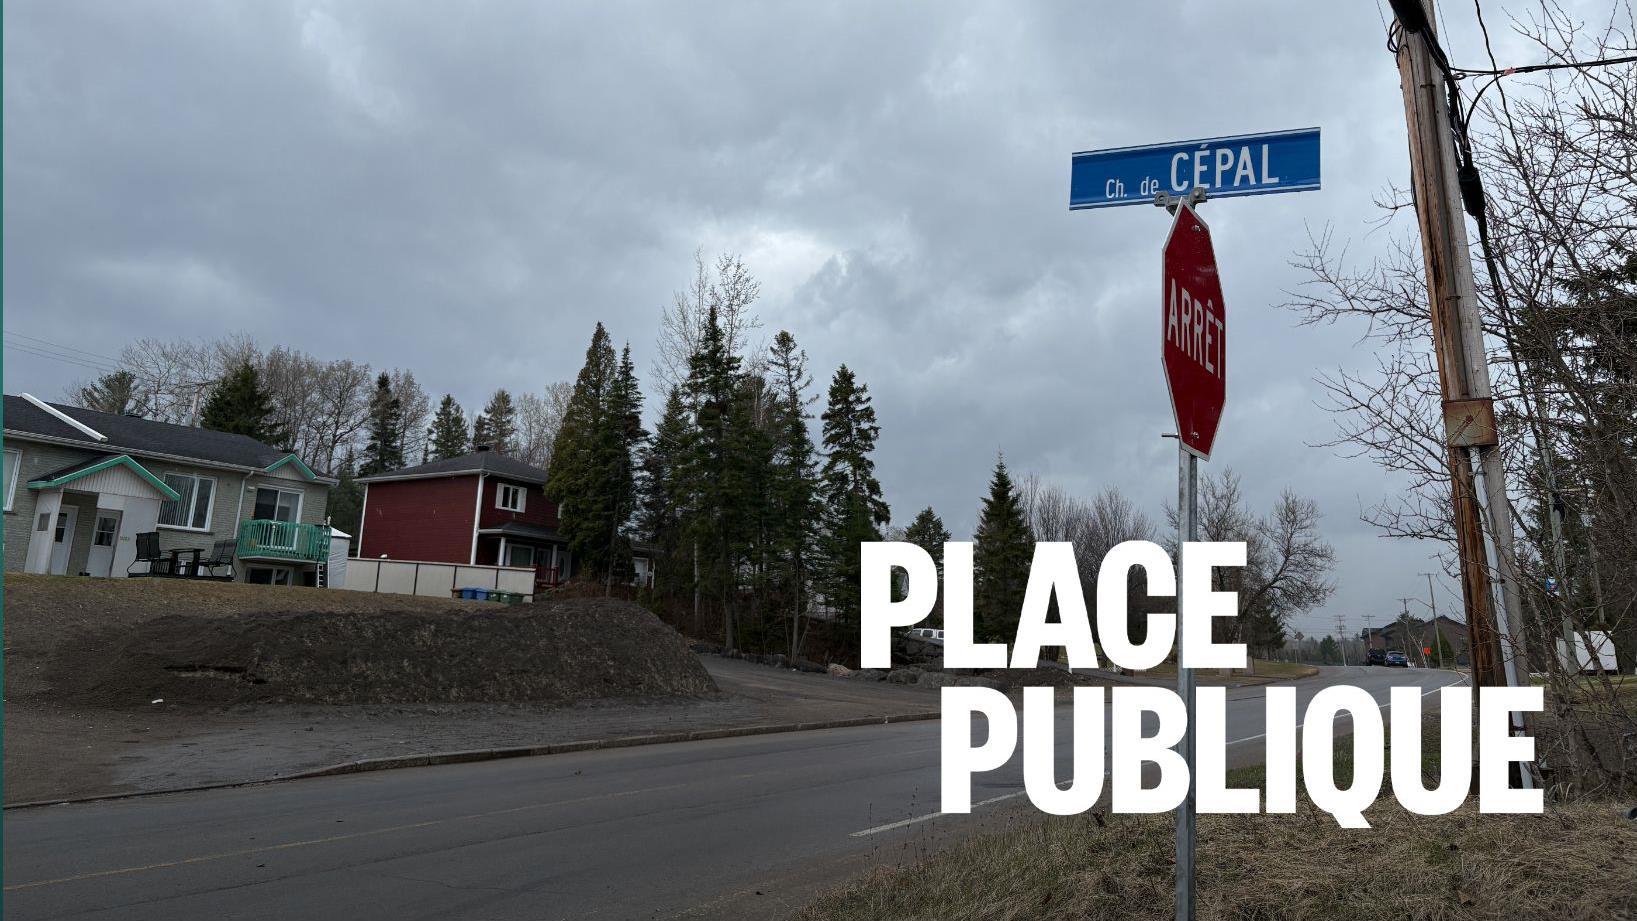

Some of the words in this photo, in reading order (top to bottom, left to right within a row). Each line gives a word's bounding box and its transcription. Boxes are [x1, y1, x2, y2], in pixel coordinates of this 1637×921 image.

[1105, 178, 1128, 199] Ch.
[1140, 176, 1160, 196] de
[1170, 144, 1279, 192] CÉPAL
[1167, 278, 1223, 379] ARRÊT
